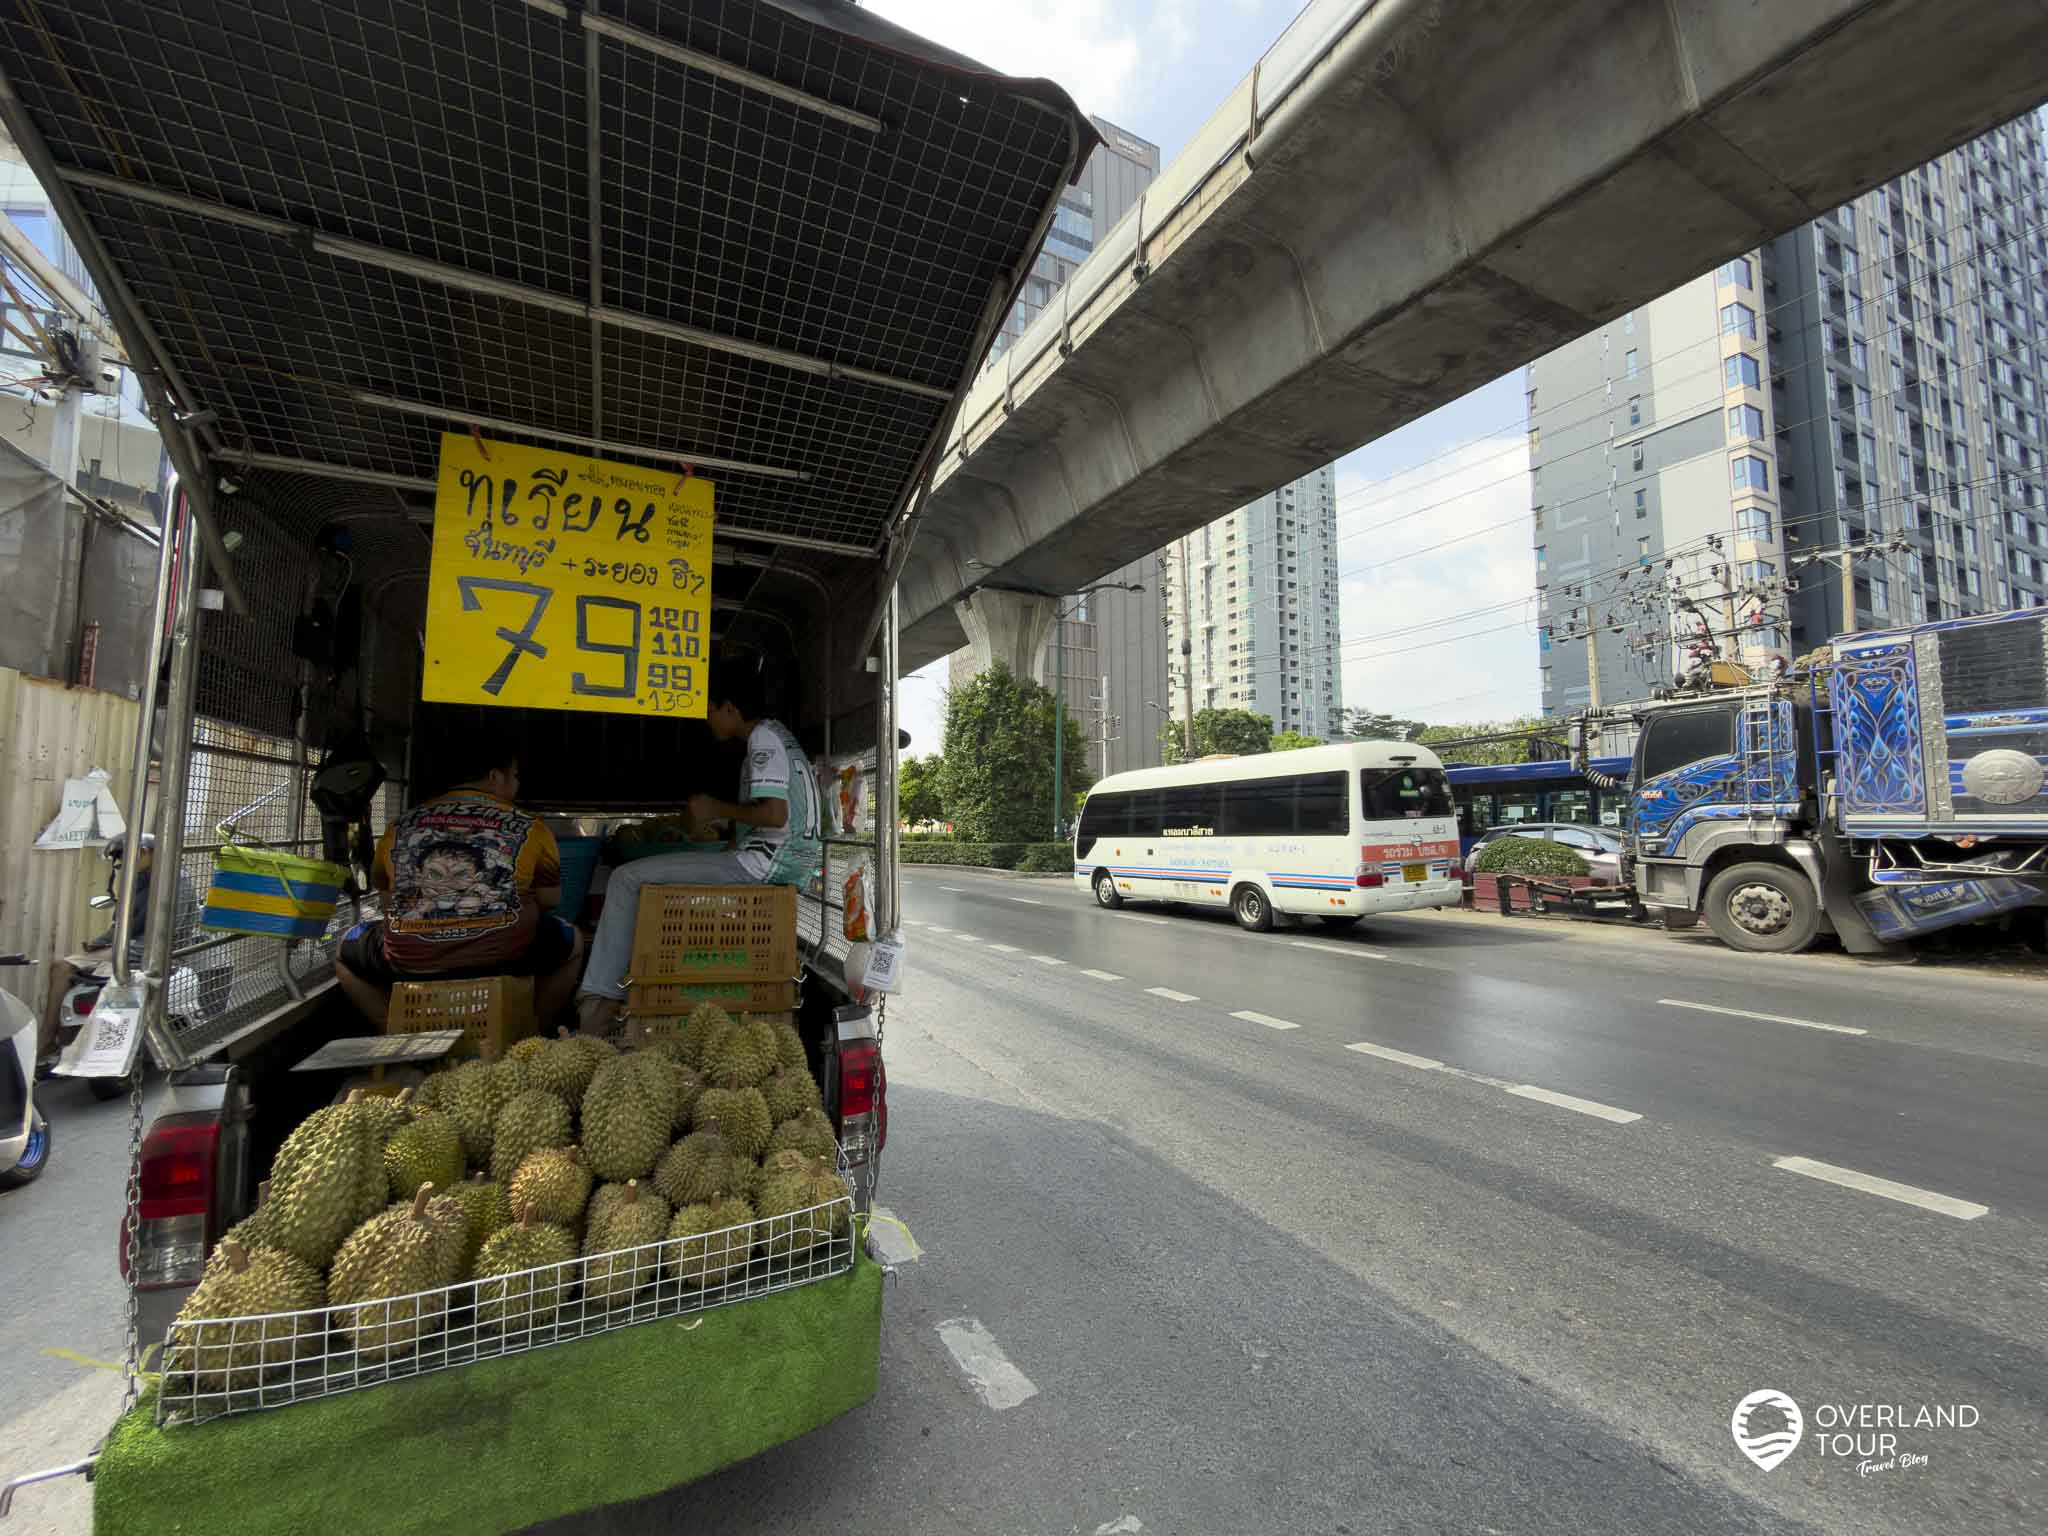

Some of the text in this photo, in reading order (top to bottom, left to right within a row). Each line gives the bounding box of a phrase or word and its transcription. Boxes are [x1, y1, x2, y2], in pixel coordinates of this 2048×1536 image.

[648, 606, 700, 633] 120
[457, 576, 641, 698] 79
[651, 631, 700, 658] 110
[647, 662, 693, 692] 99
[648, 689, 694, 712] 130
